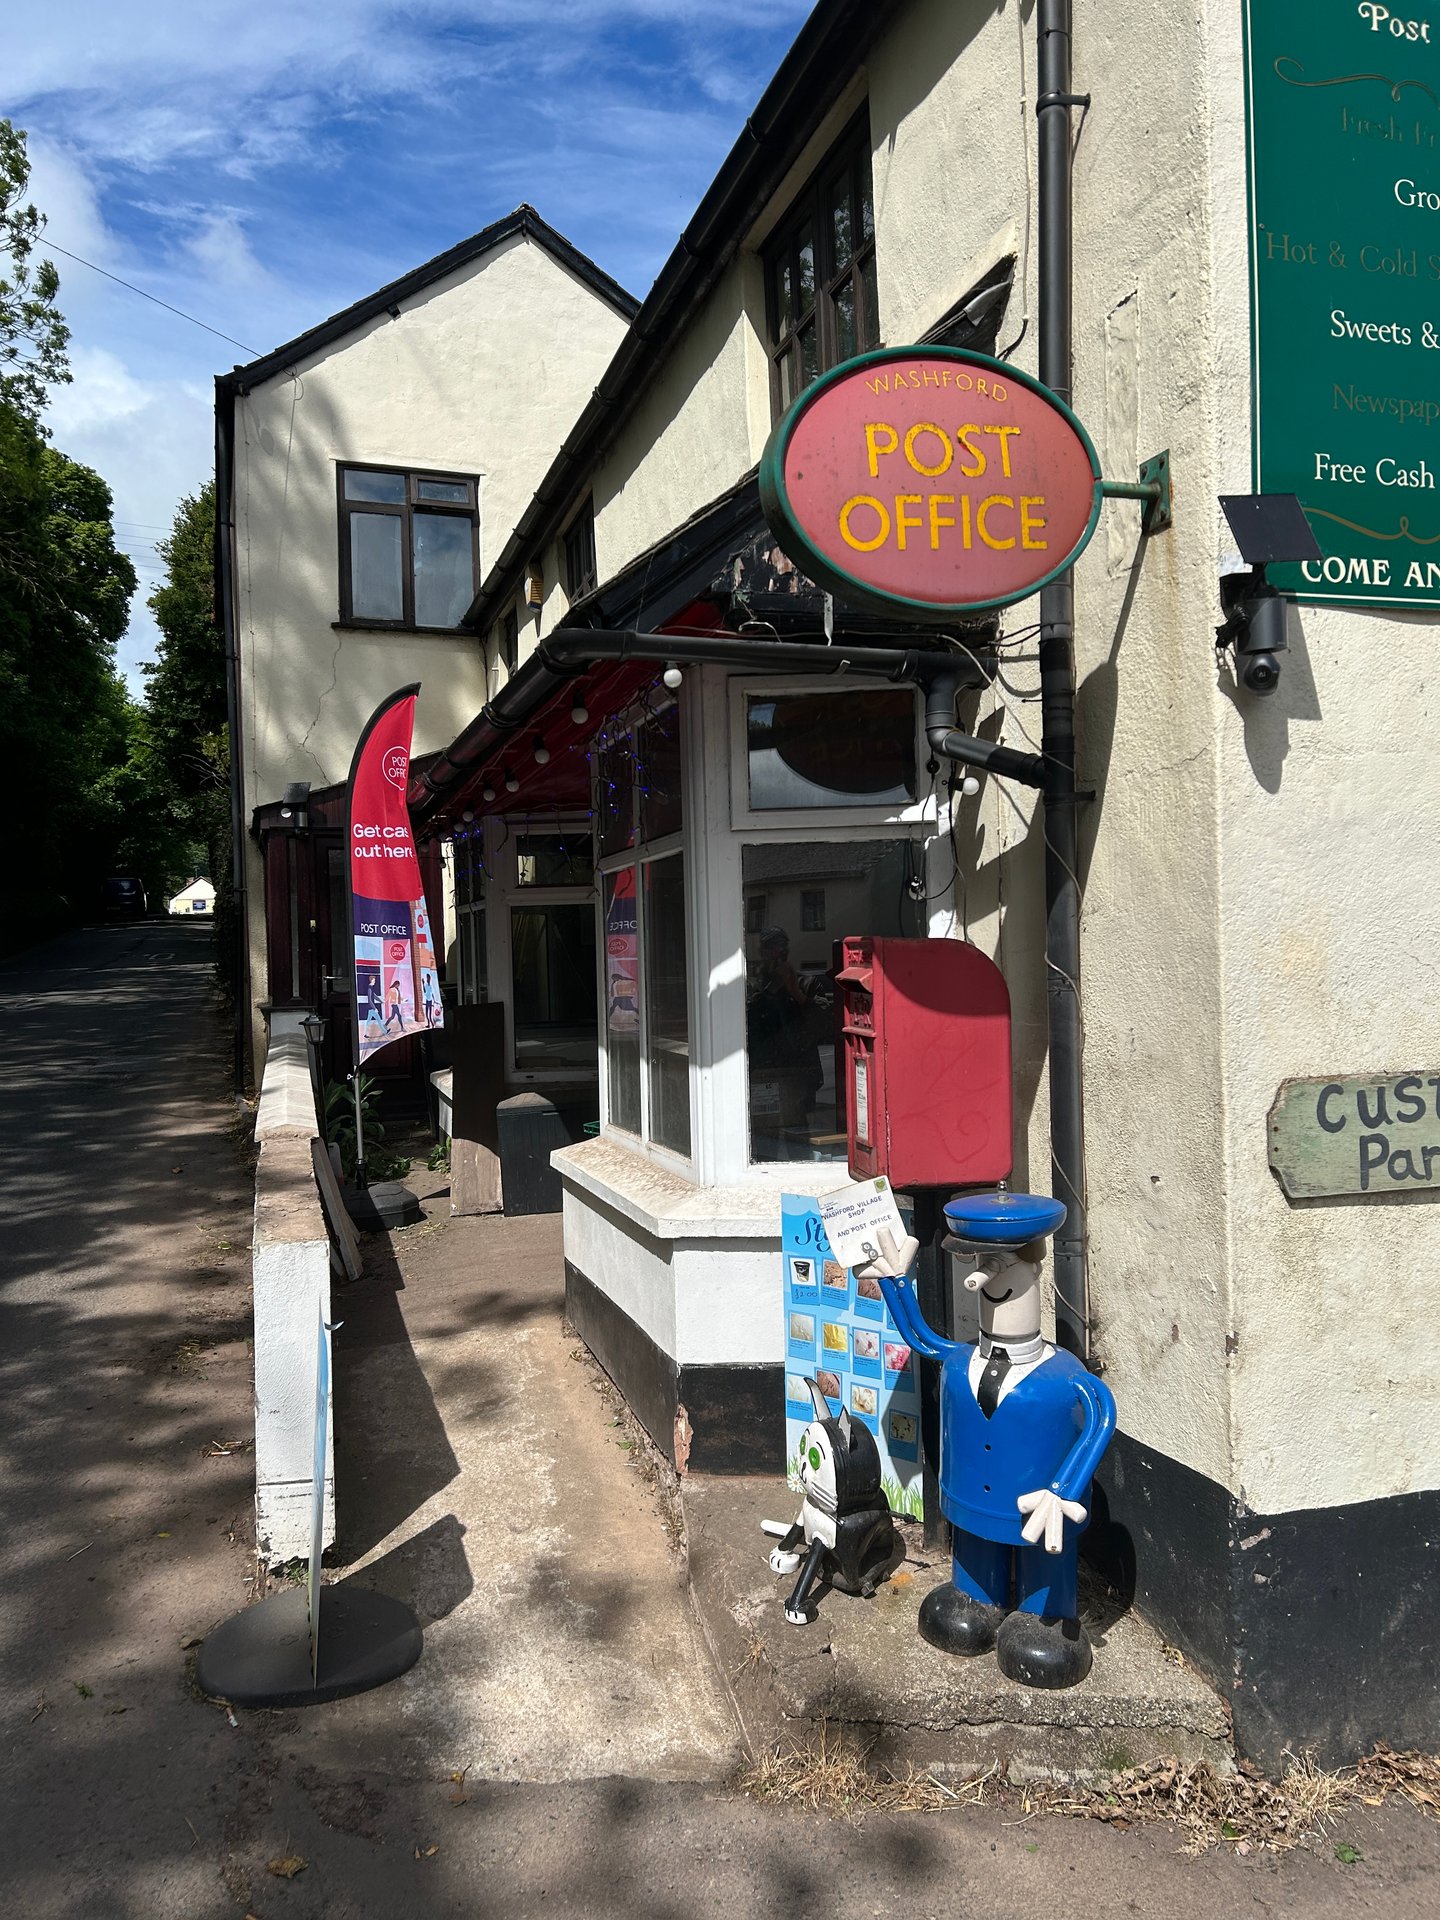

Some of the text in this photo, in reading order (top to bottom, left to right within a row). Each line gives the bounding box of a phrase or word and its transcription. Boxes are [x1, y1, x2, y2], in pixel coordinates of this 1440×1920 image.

[1358, 1, 1431, 44] Post
[1394, 178, 1440, 211] Gro
[1266, 232, 1318, 264] Hot
[1328, 240, 1348, 269] &
[1360, 245, 1417, 278] Cold
[1330, 309, 1440, 350] Sweets &
[865, 369, 1009, 403] WASHFORD
[1332, 383, 1440, 426] Newspap
[864, 422, 1022, 479] POST
[1314, 452, 1435, 489] Free Cash
[838, 494, 1048, 552] OFFICE
[1301, 556, 1392, 586] COME
[353, 823, 382, 838] Get
[354, 844, 382, 858] out
[360, 922, 407, 936] POST OFFICE
[823, 1205, 855, 1220] WASHFORD
[856, 1195, 882, 1208] VILLAGE
[848, 1208, 865, 1219] SHOP
[837, 1214, 892, 1238] AND POST OFFICE
